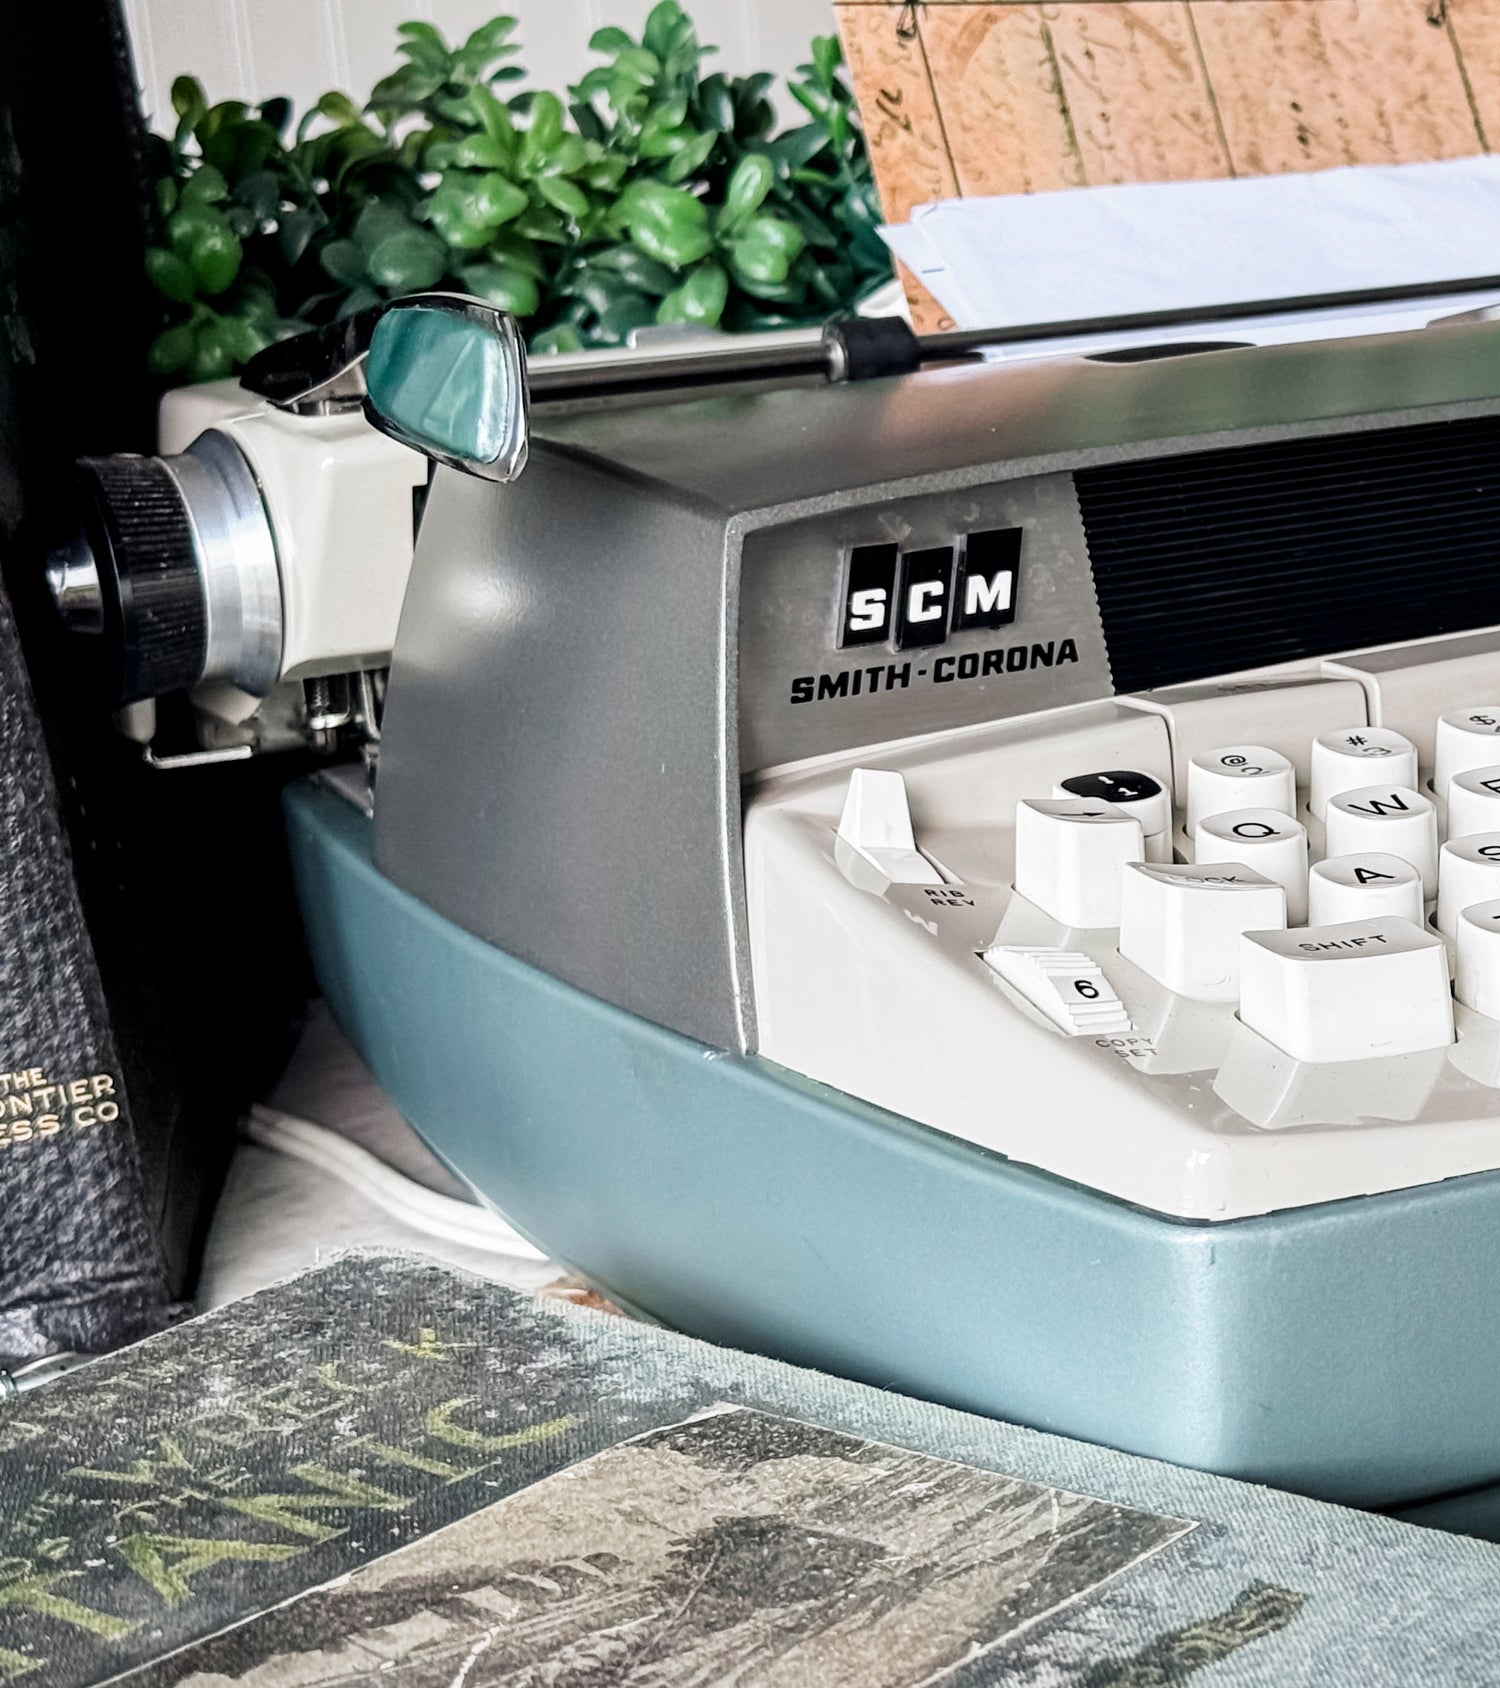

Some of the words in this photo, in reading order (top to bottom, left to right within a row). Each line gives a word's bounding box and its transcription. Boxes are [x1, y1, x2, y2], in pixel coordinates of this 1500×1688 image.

[849, 569, 1013, 632] SCM
[790, 638, 1080, 705] SMITH-CORONA
[1345, 735, 1368, 747] #
[1220, 754, 1247, 766] @
[1348, 793, 1410, 817] W
[1232, 821, 1281, 839] Q
[1354, 866, 1396, 885] A
[923, 888, 966, 898] RIB
[930, 898, 976, 907] REV
[1297, 933, 1389, 957] SHIFT
[1073, 978, 1102, 999] 6
[1095, 1037, 1154, 1048] COPY
[1114, 1048, 1159, 1058] SET
[0, 1067, 47, 1095] THE
[74, 1101, 119, 1129] CO
